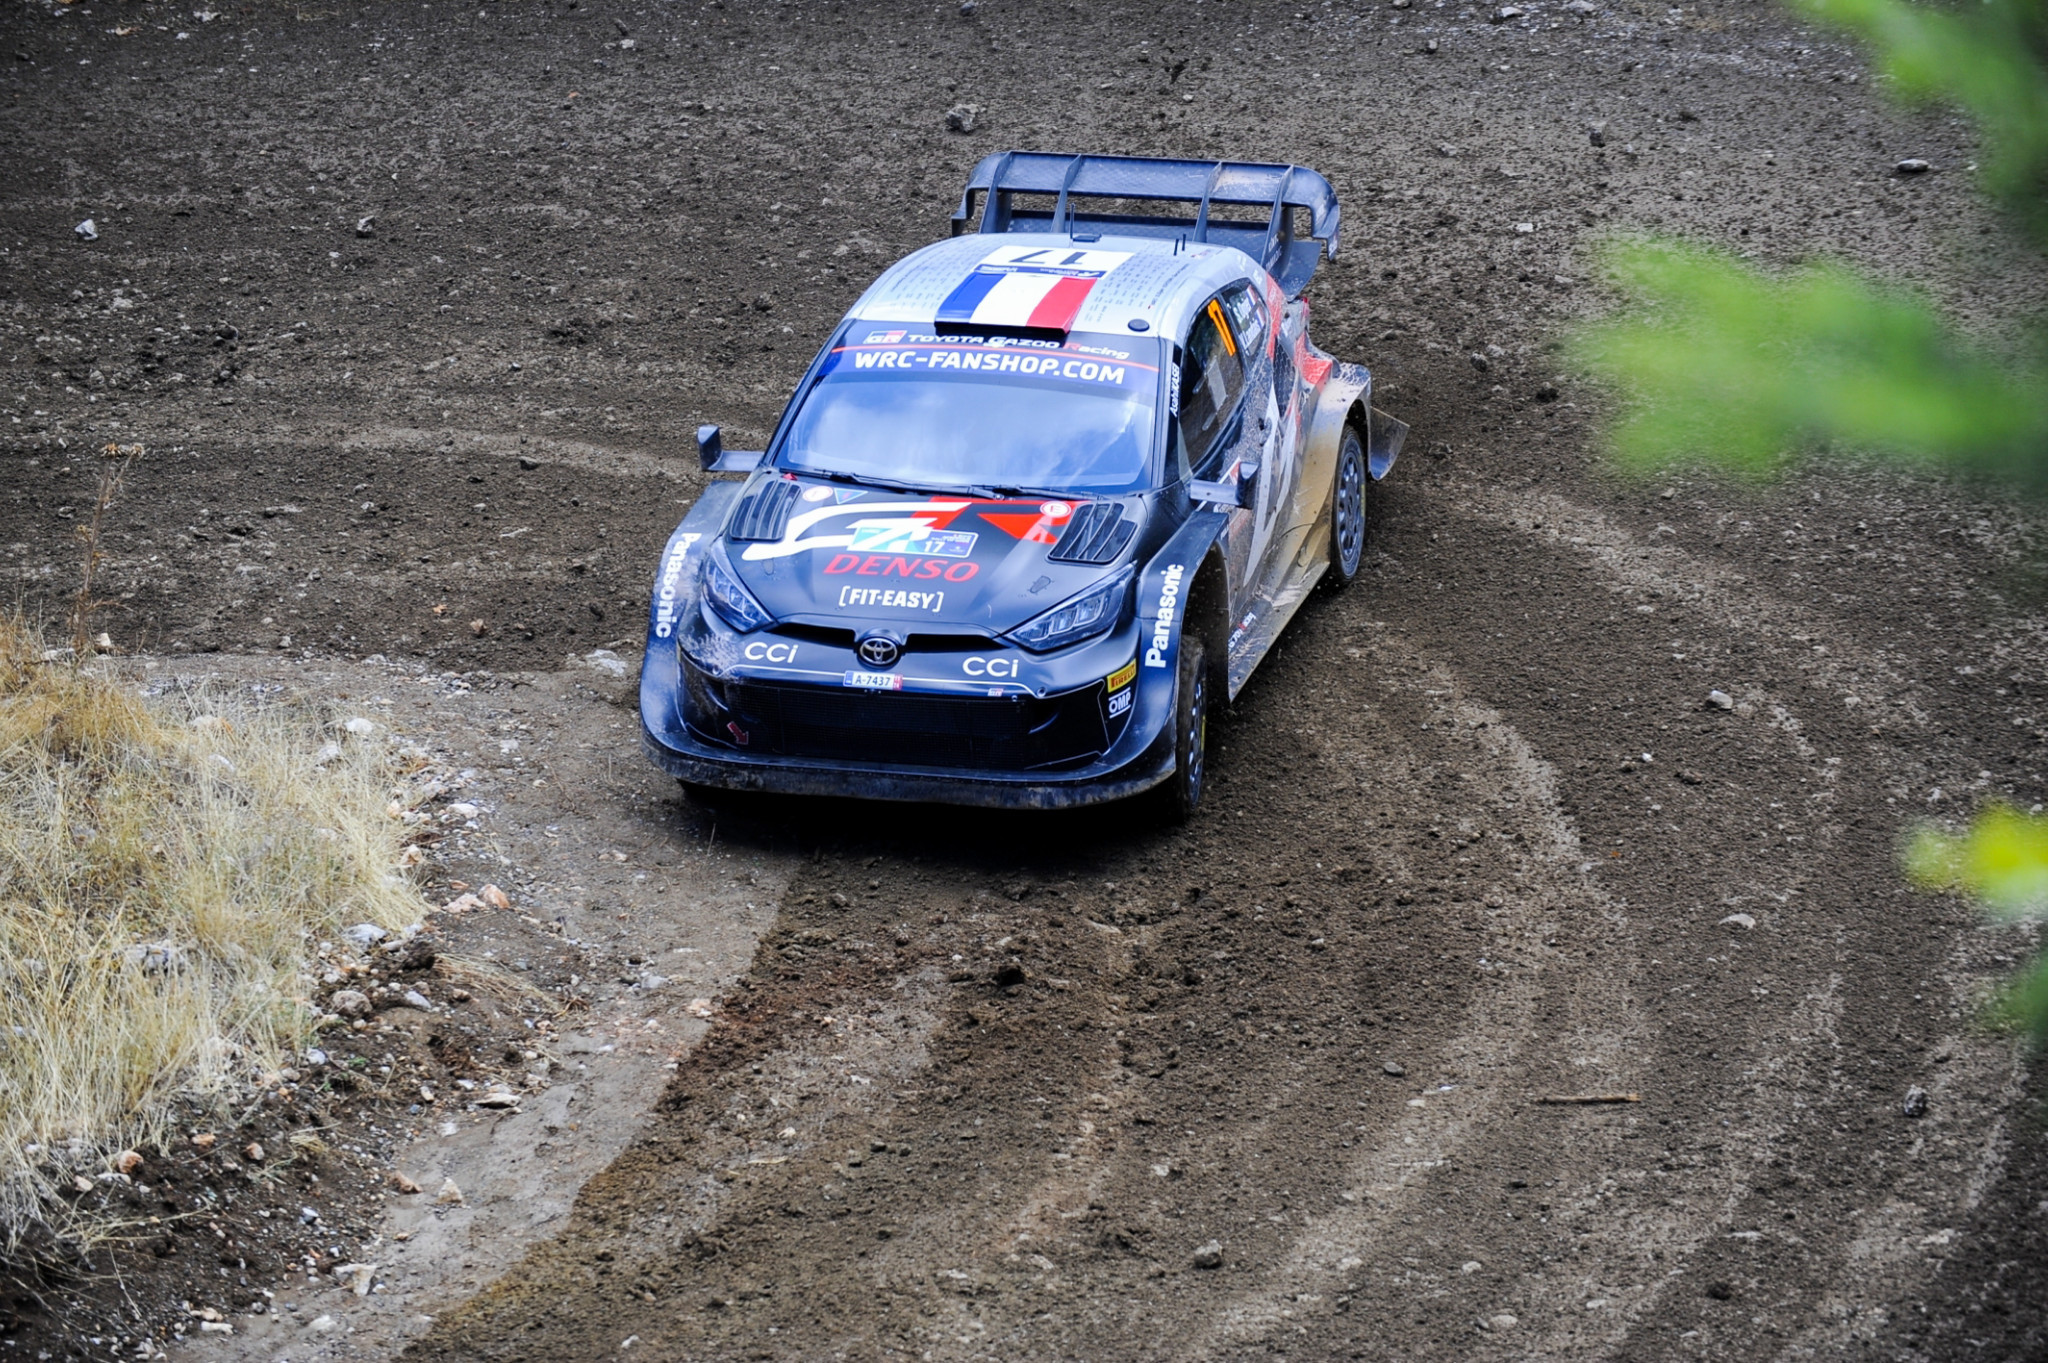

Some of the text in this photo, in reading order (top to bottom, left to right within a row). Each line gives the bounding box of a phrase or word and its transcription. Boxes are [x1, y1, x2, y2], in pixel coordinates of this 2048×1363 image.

[907, 334, 984, 344] TOYOTA
[1062, 342, 1130, 360] Racing
[855, 351, 1125, 385] WRC-FANSHOP.COM
[924, 540, 945, 553] 17
[822, 553, 980, 583] DENSO
[655, 532, 703, 638] Panasonic
[1144, 563, 1185, 668] Panasonic
[1108, 690, 1132, 714] OMP
